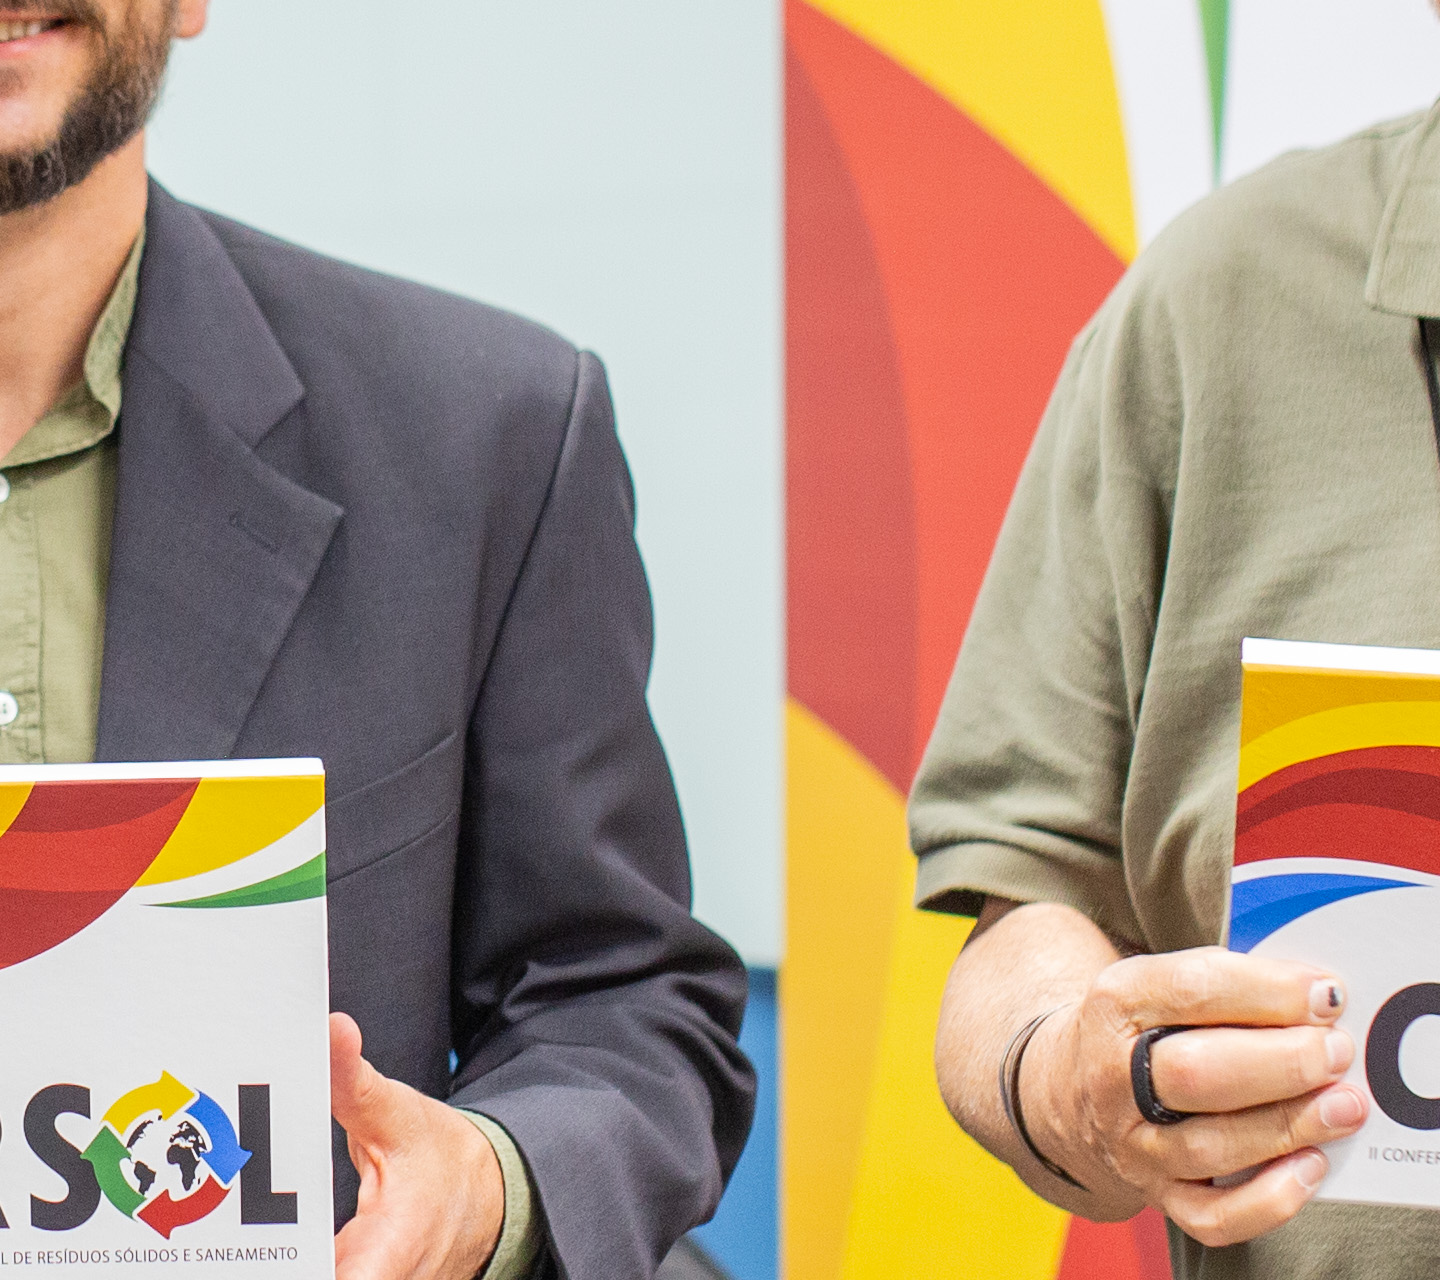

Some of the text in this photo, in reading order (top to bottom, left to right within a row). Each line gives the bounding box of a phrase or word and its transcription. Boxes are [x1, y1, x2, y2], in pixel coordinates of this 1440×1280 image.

[1368, 1146, 1378, 1161] II
[13, 1251, 32, 1265] DE
[37, 1247, 110, 1264] RESÍDUOS
[114, 1246, 179, 1263] SÓLIDOS
[183, 1248, 191, 1262] E
[196, 1246, 298, 1262] SANEAMENTO
